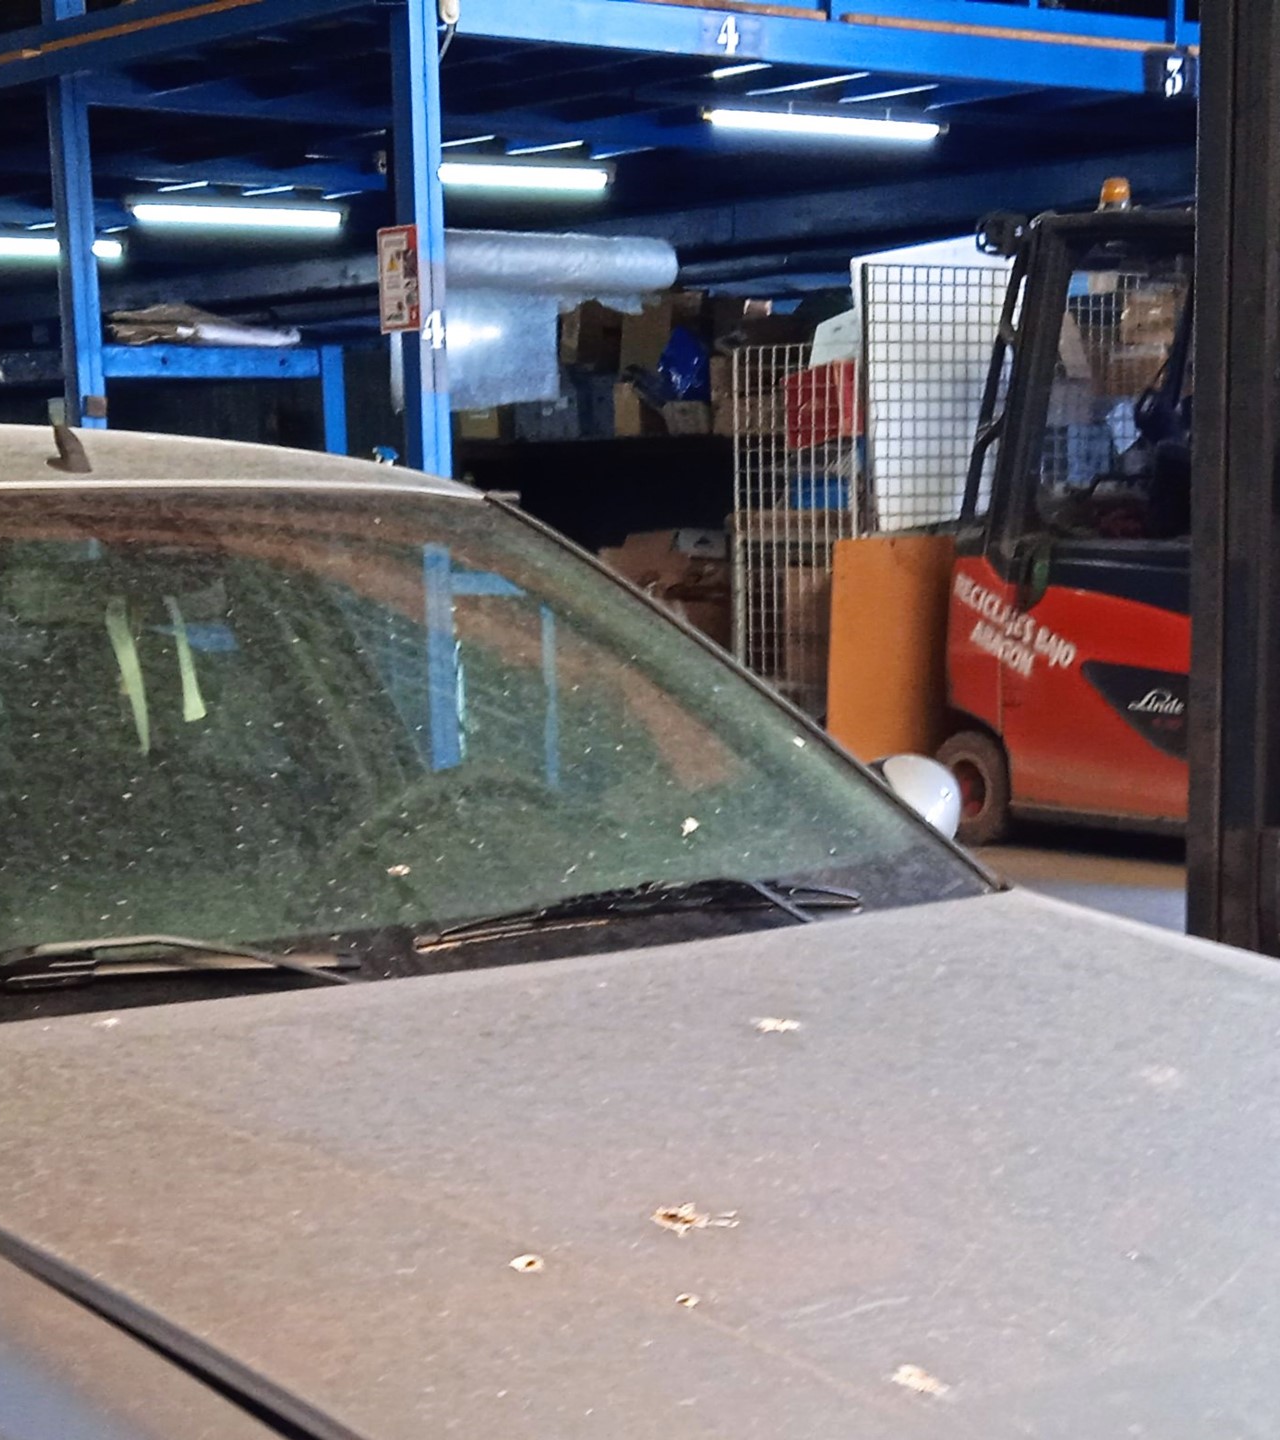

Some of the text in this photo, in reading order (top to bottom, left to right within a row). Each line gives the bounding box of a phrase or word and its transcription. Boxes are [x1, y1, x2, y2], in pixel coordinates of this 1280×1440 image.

[716, 14, 739, 56] 4
[1164, 56, 1184, 98] 3
[421, 308, 445, 349] 4
[1127, 688, 1185, 715] Linde
